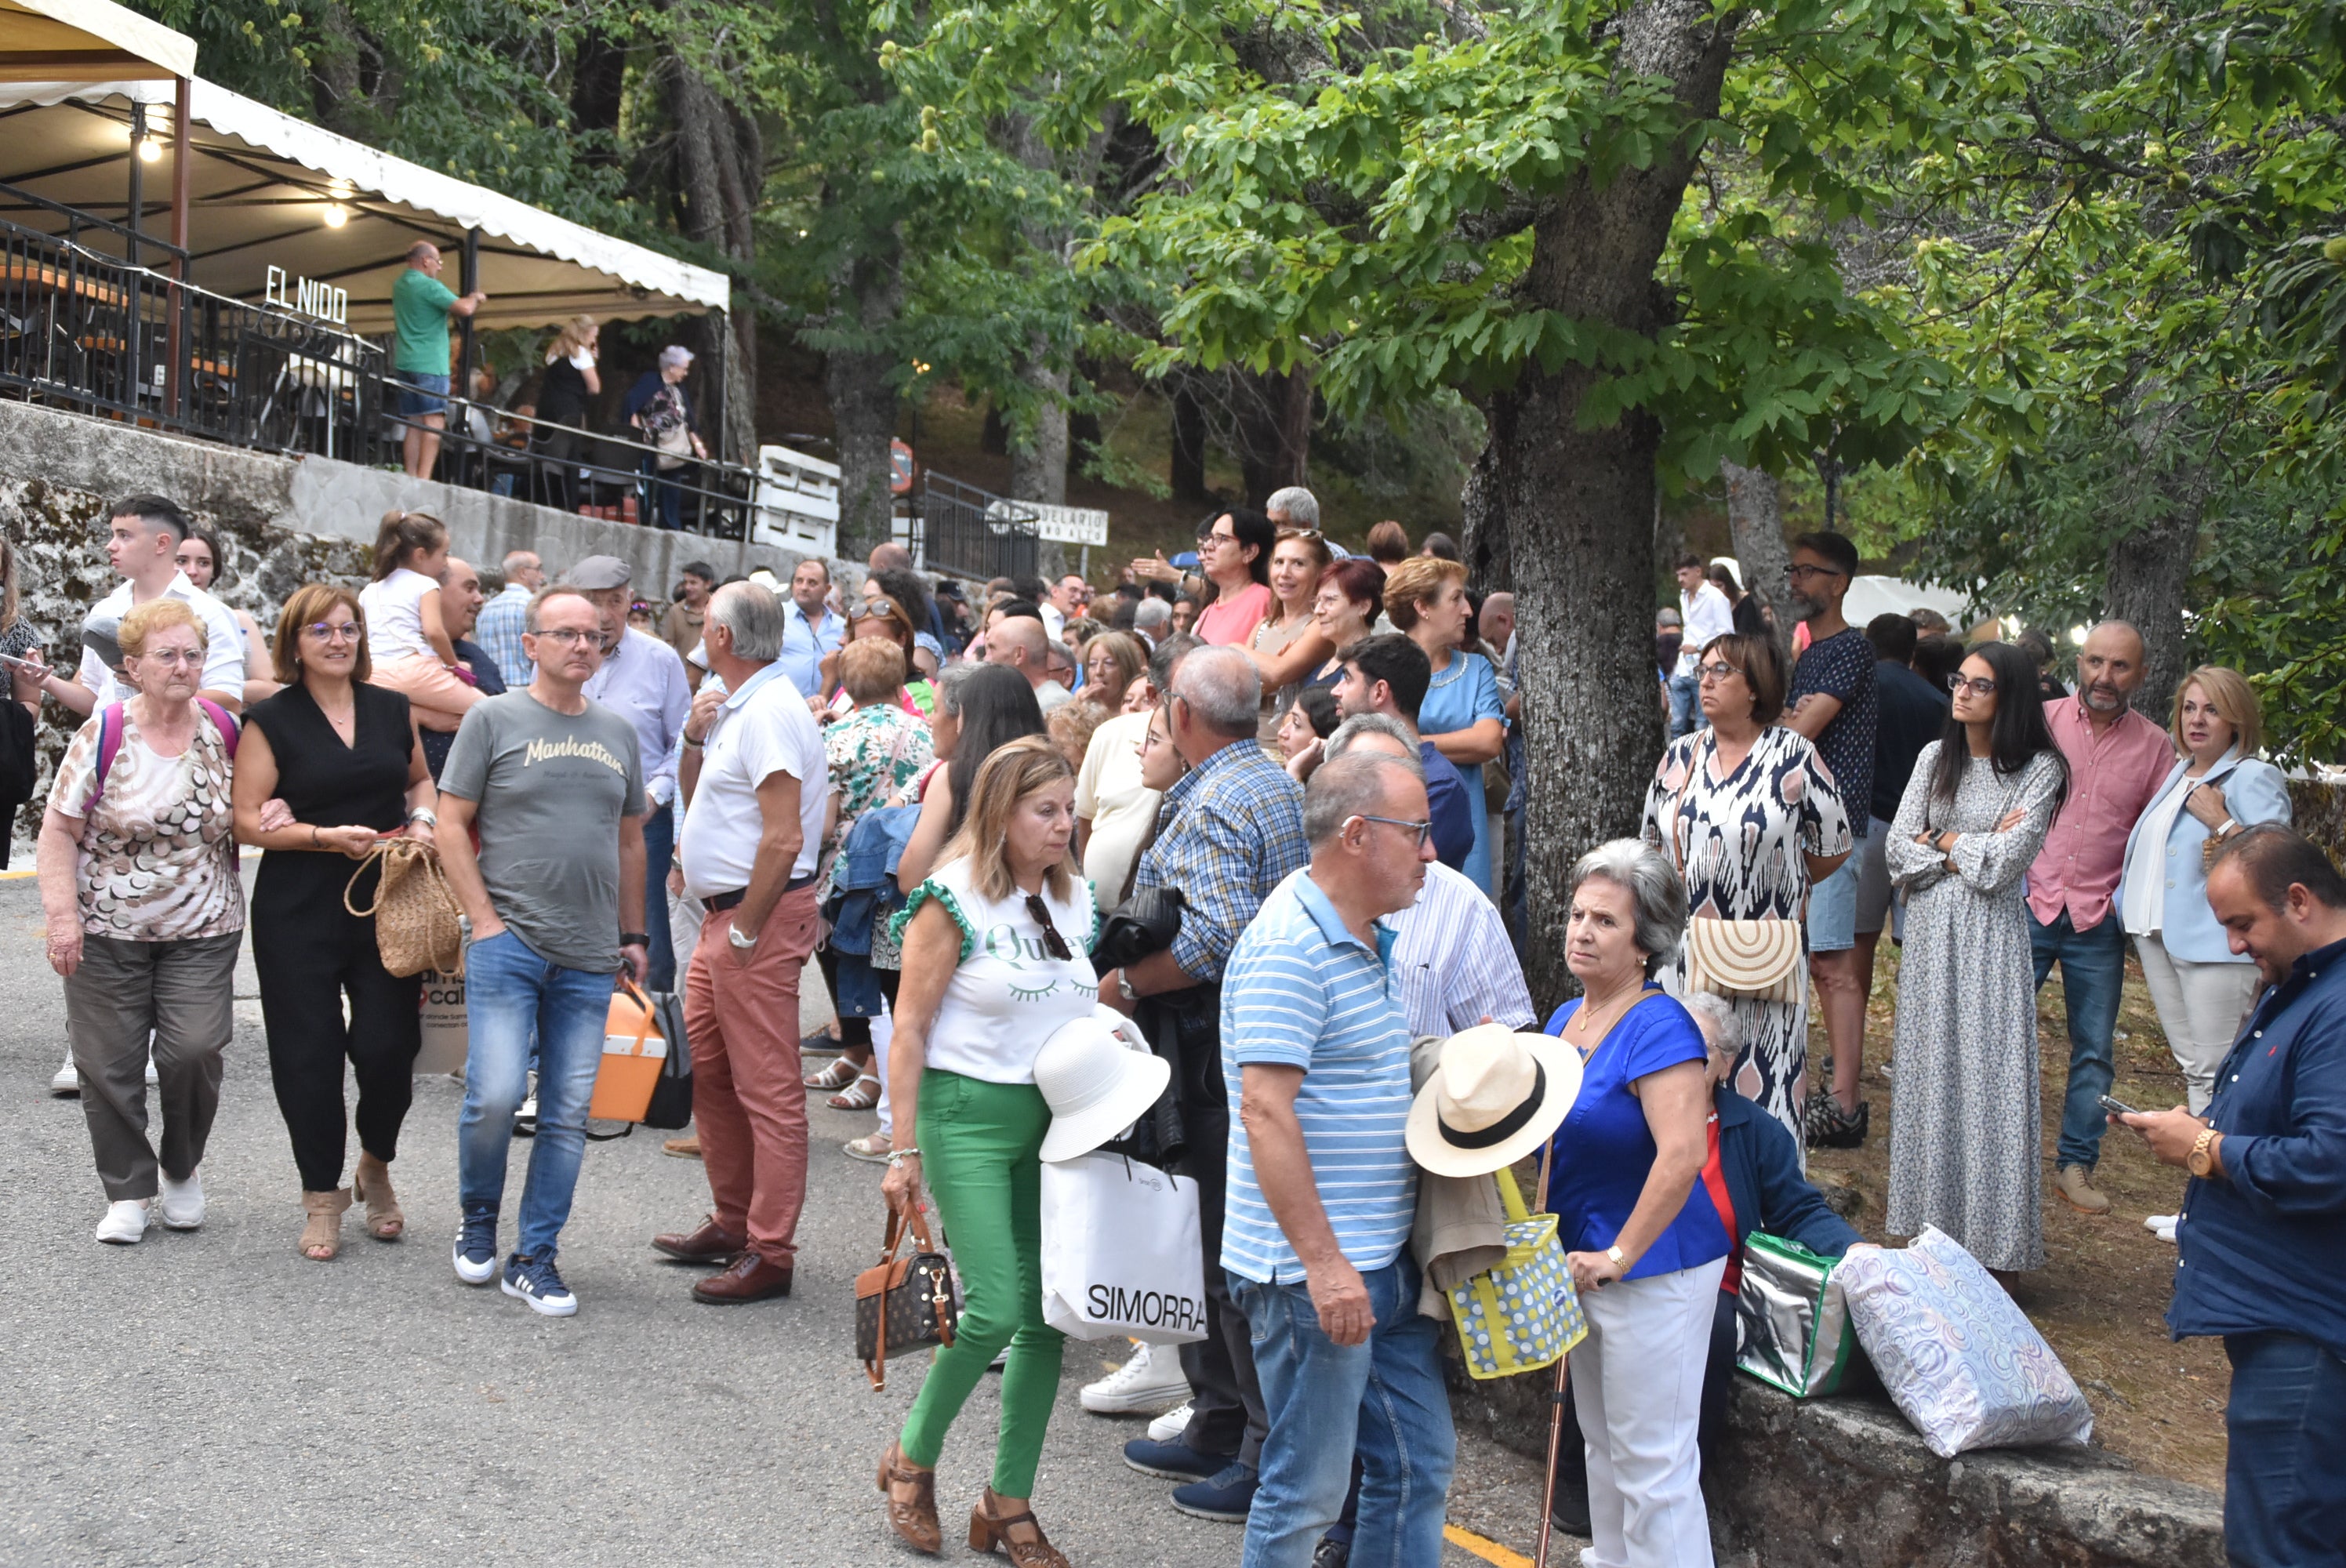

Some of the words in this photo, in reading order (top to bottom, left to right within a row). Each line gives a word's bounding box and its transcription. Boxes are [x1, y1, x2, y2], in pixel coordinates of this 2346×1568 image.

[266, 265, 293, 309] EL
[297, 275, 347, 325] NIDO
[524, 735, 626, 776] Manhattan
